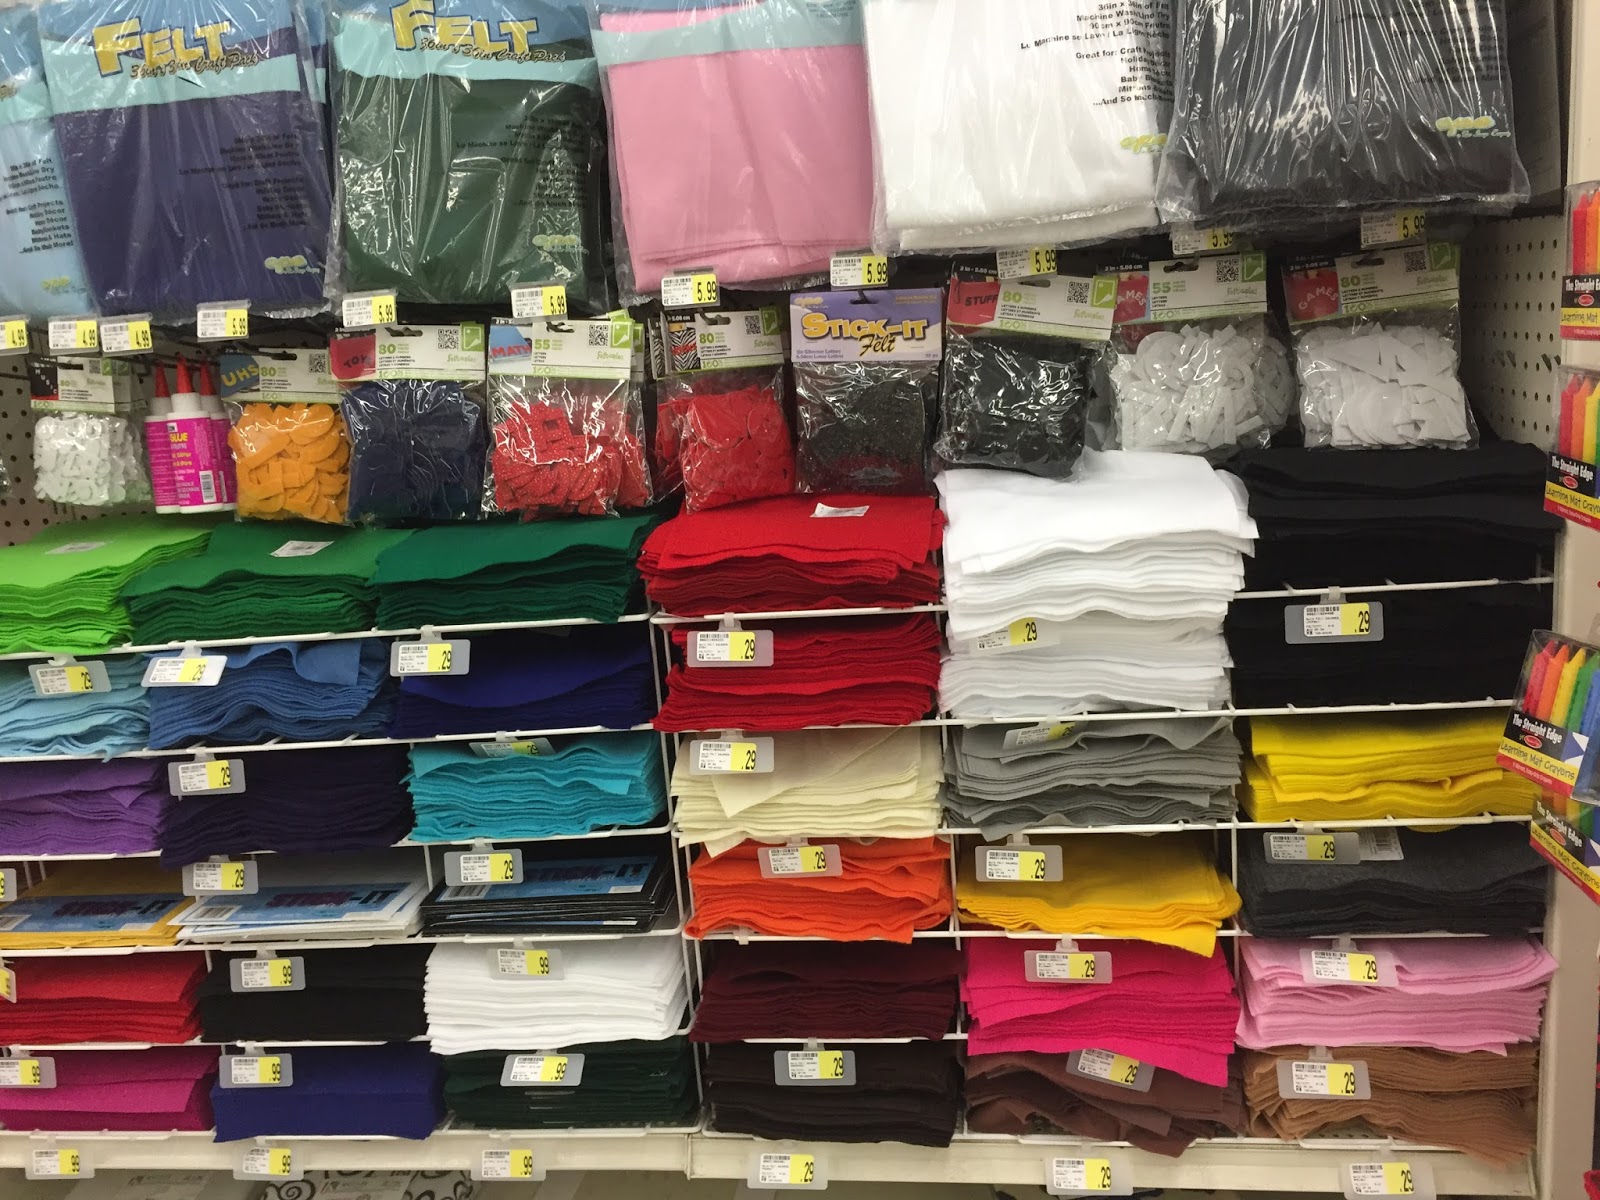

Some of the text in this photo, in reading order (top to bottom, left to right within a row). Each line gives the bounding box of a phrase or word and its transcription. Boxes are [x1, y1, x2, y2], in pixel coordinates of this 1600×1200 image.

[389, 0, 538, 54] FELT
[1076, 13, 1113, 22] Machine
[92, 16, 232, 78] FELT
[1076, 51, 1100, 60] Great
[1120, 46, 1142, 55] Craft
[195, 53, 225, 75] Craft
[228, 52, 260, 69] Pack
[1035, 248, 1057, 273] 5.99
[867, 262, 888, 283] 5.99
[1341, 275, 1361, 288] 80
[697, 281, 717, 302] 5.99
[1152, 281, 1171, 294] 55
[1565, 279, 1574, 291] The
[1574, 278, 1595, 293] Straight
[550, 295, 565, 314] 5.99
[965, 294, 998, 306] STUFF
[1003, 290, 1023, 304] 80
[1298, 286, 1338, 310] GAMES
[378, 304, 393, 323] 5.99
[232, 318, 246, 336] 5.99
[802, 312, 928, 340] STICK-IT
[534, 339, 550, 350] 55
[699, 332, 715, 344] 80
[859, 334, 896, 357] Felt
[378, 343, 396, 354] 80
[260, 366, 277, 377] 80
[1551, 455, 1594, 482] The Straight Edge
[1569, 494, 1581, 508] Mat
[1354, 610, 1371, 633] .29
[1023, 621, 1038, 643] .29
[741, 638, 756, 660] .29
[438, 650, 452, 671] .29
[81, 671, 94, 691] .29
[188, 663, 206, 681] .29
[1513, 713, 1563, 745] The Straight Edge
[741, 749, 757, 771] .29
[1500, 740, 1528, 760] Learning
[1530, 754, 1543, 768] Mat
[1543, 761, 1575, 780] Crayons
[219, 766, 231, 787] .29
[1536, 800, 1583, 848] The Straight Edge
[1320, 841, 1336, 859] .29
[500, 860, 513, 880] .29
[813, 851, 827, 870] .29
[1031, 859, 1046, 880] .29
[1558, 849, 1571, 866] Mat
[1571, 861, 1600, 889] Crayons
[231, 868, 245, 888] .29
[536, 956, 550, 974] .99
[1081, 959, 1096, 978] .29
[1363, 960, 1379, 980] .29
[551, 1062, 567, 1081] .99
[831, 1057, 845, 1077] .29
[1120, 1064, 1140, 1085] .29
[1341, 1071, 1356, 1094] .29
[800, 1161, 815, 1183] .29
[1098, 1166, 1112, 1189] .29
[1400, 1169, 1415, 1192] .29
